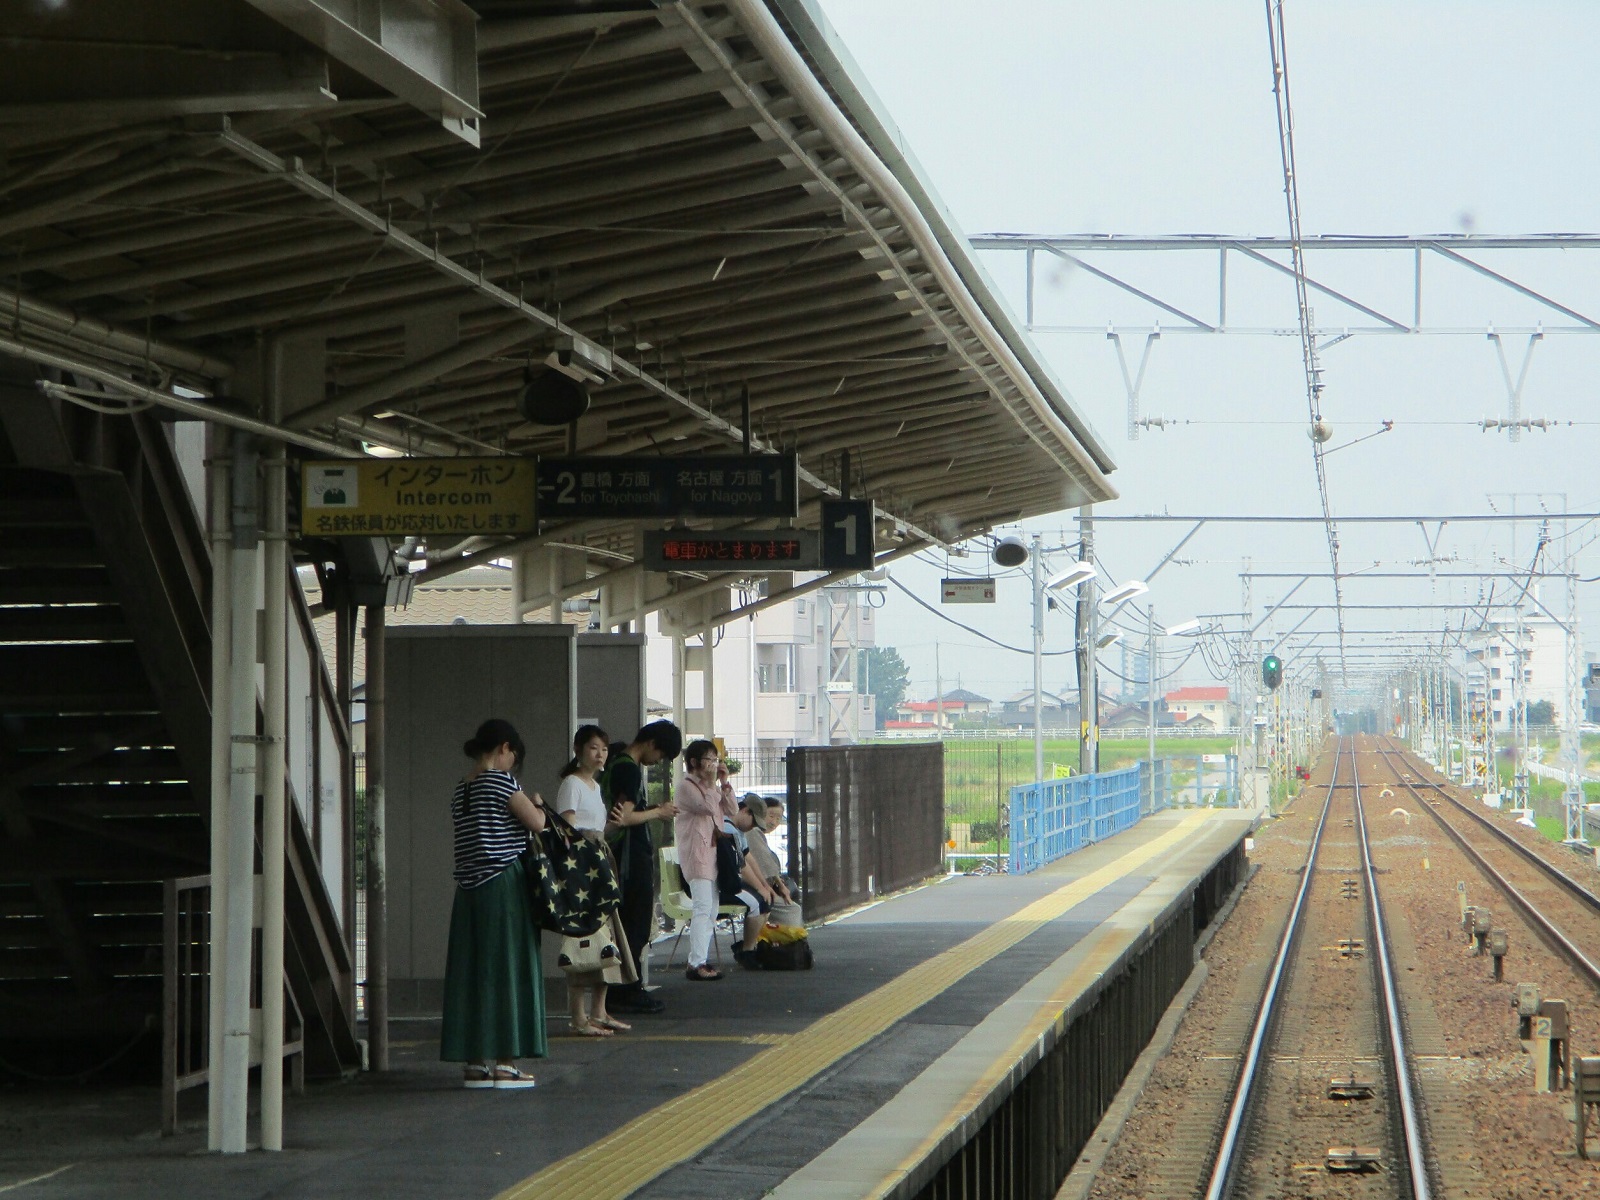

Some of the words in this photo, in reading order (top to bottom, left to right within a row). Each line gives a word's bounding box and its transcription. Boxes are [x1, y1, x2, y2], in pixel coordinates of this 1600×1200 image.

[374, 465, 515, 487] インターホン
[618, 471, 649, 487] 方面
[677, 470, 724, 487] 名古屋
[731, 470, 762, 486] 方面
[768, 469, 783, 501] 1
[557, 472, 576, 504] 2
[397, 490, 492, 506] Intercom
[580, 491, 596, 503] for
[600, 491, 661, 507] Toyohashi
[691, 491, 706, 503] for
[712, 490, 762, 505] Nagoya
[316, 513, 521, 532] 名鉄係員が応対いたします
[834, 514, 856, 555] 1
[663, 541, 797, 560] 電車がとまります
[1537, 1020, 1551, 1036] 2
